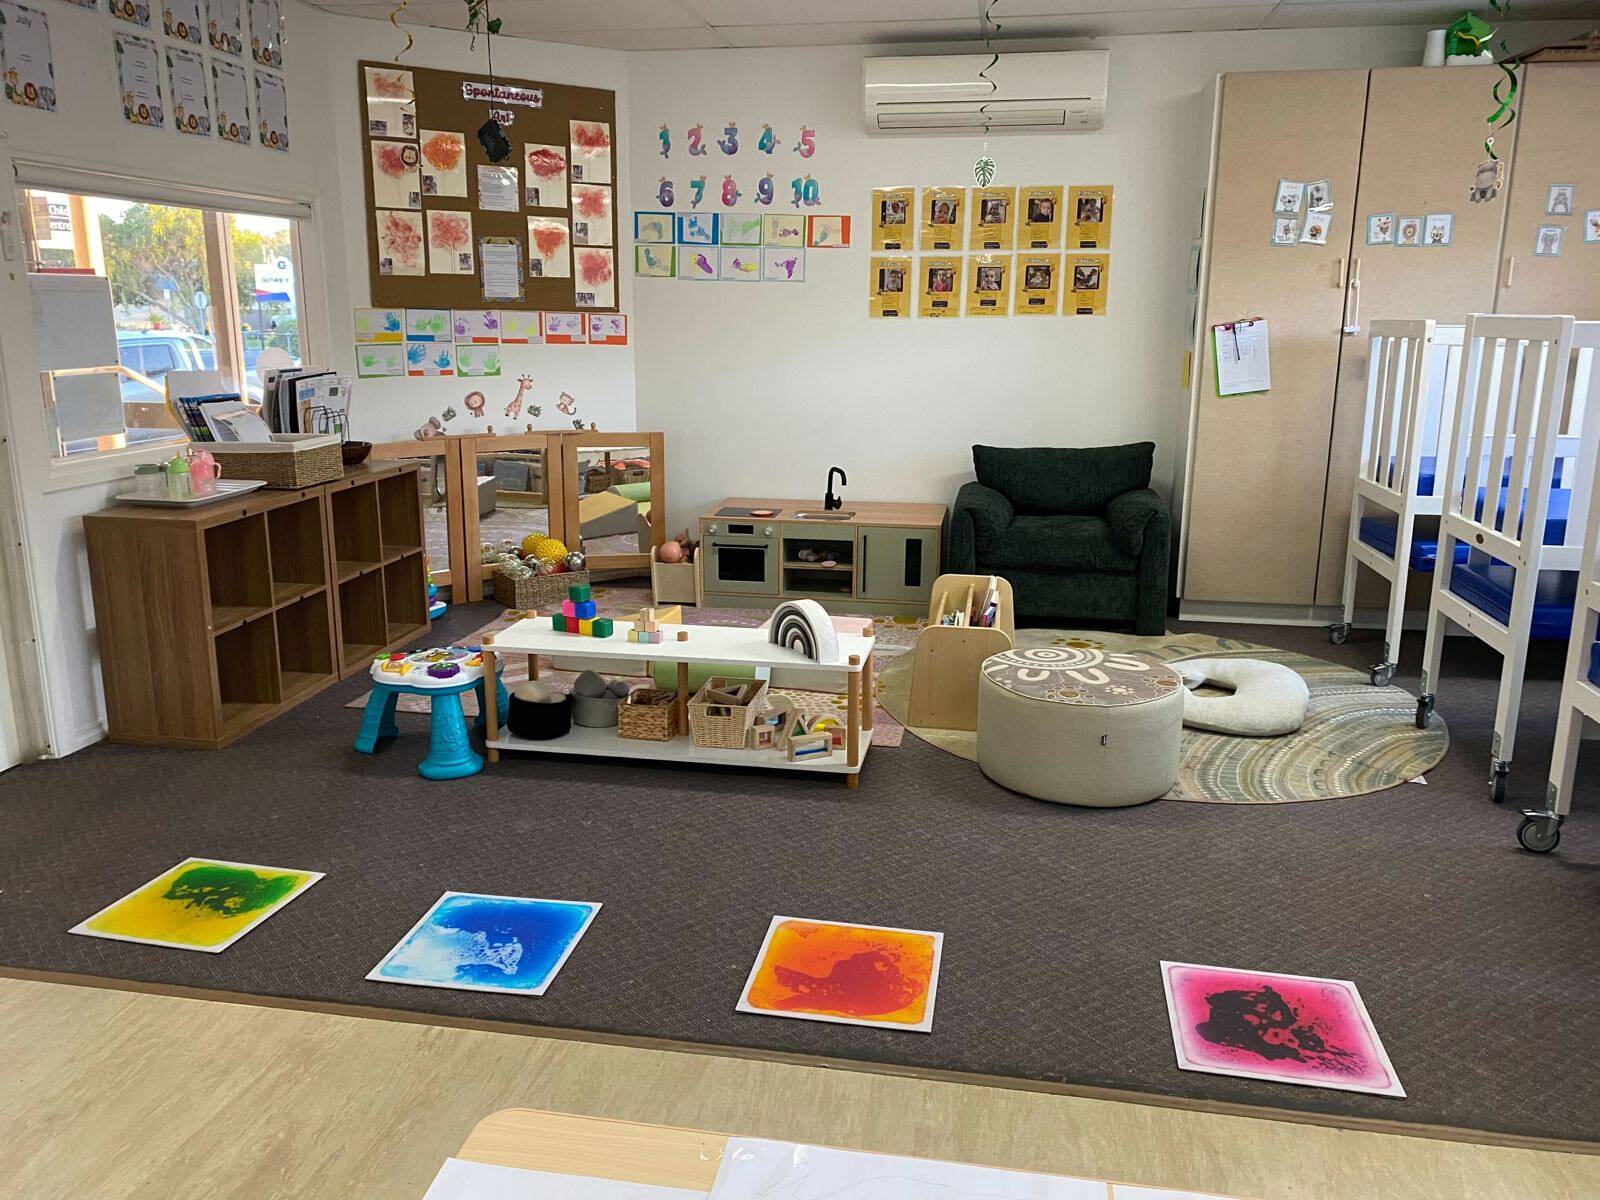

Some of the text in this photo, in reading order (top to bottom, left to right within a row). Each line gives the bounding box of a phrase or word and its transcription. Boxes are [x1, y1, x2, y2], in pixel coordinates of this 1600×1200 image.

[15, 14, 35, 29] July
[464, 82, 541, 104] Spontaneous
[493, 110, 512, 123] Art
[659, 126, 816, 159] 1 2 3 4 5
[658, 177, 820, 208] 6 7 8 9 10
[277, 260, 287, 270] G
